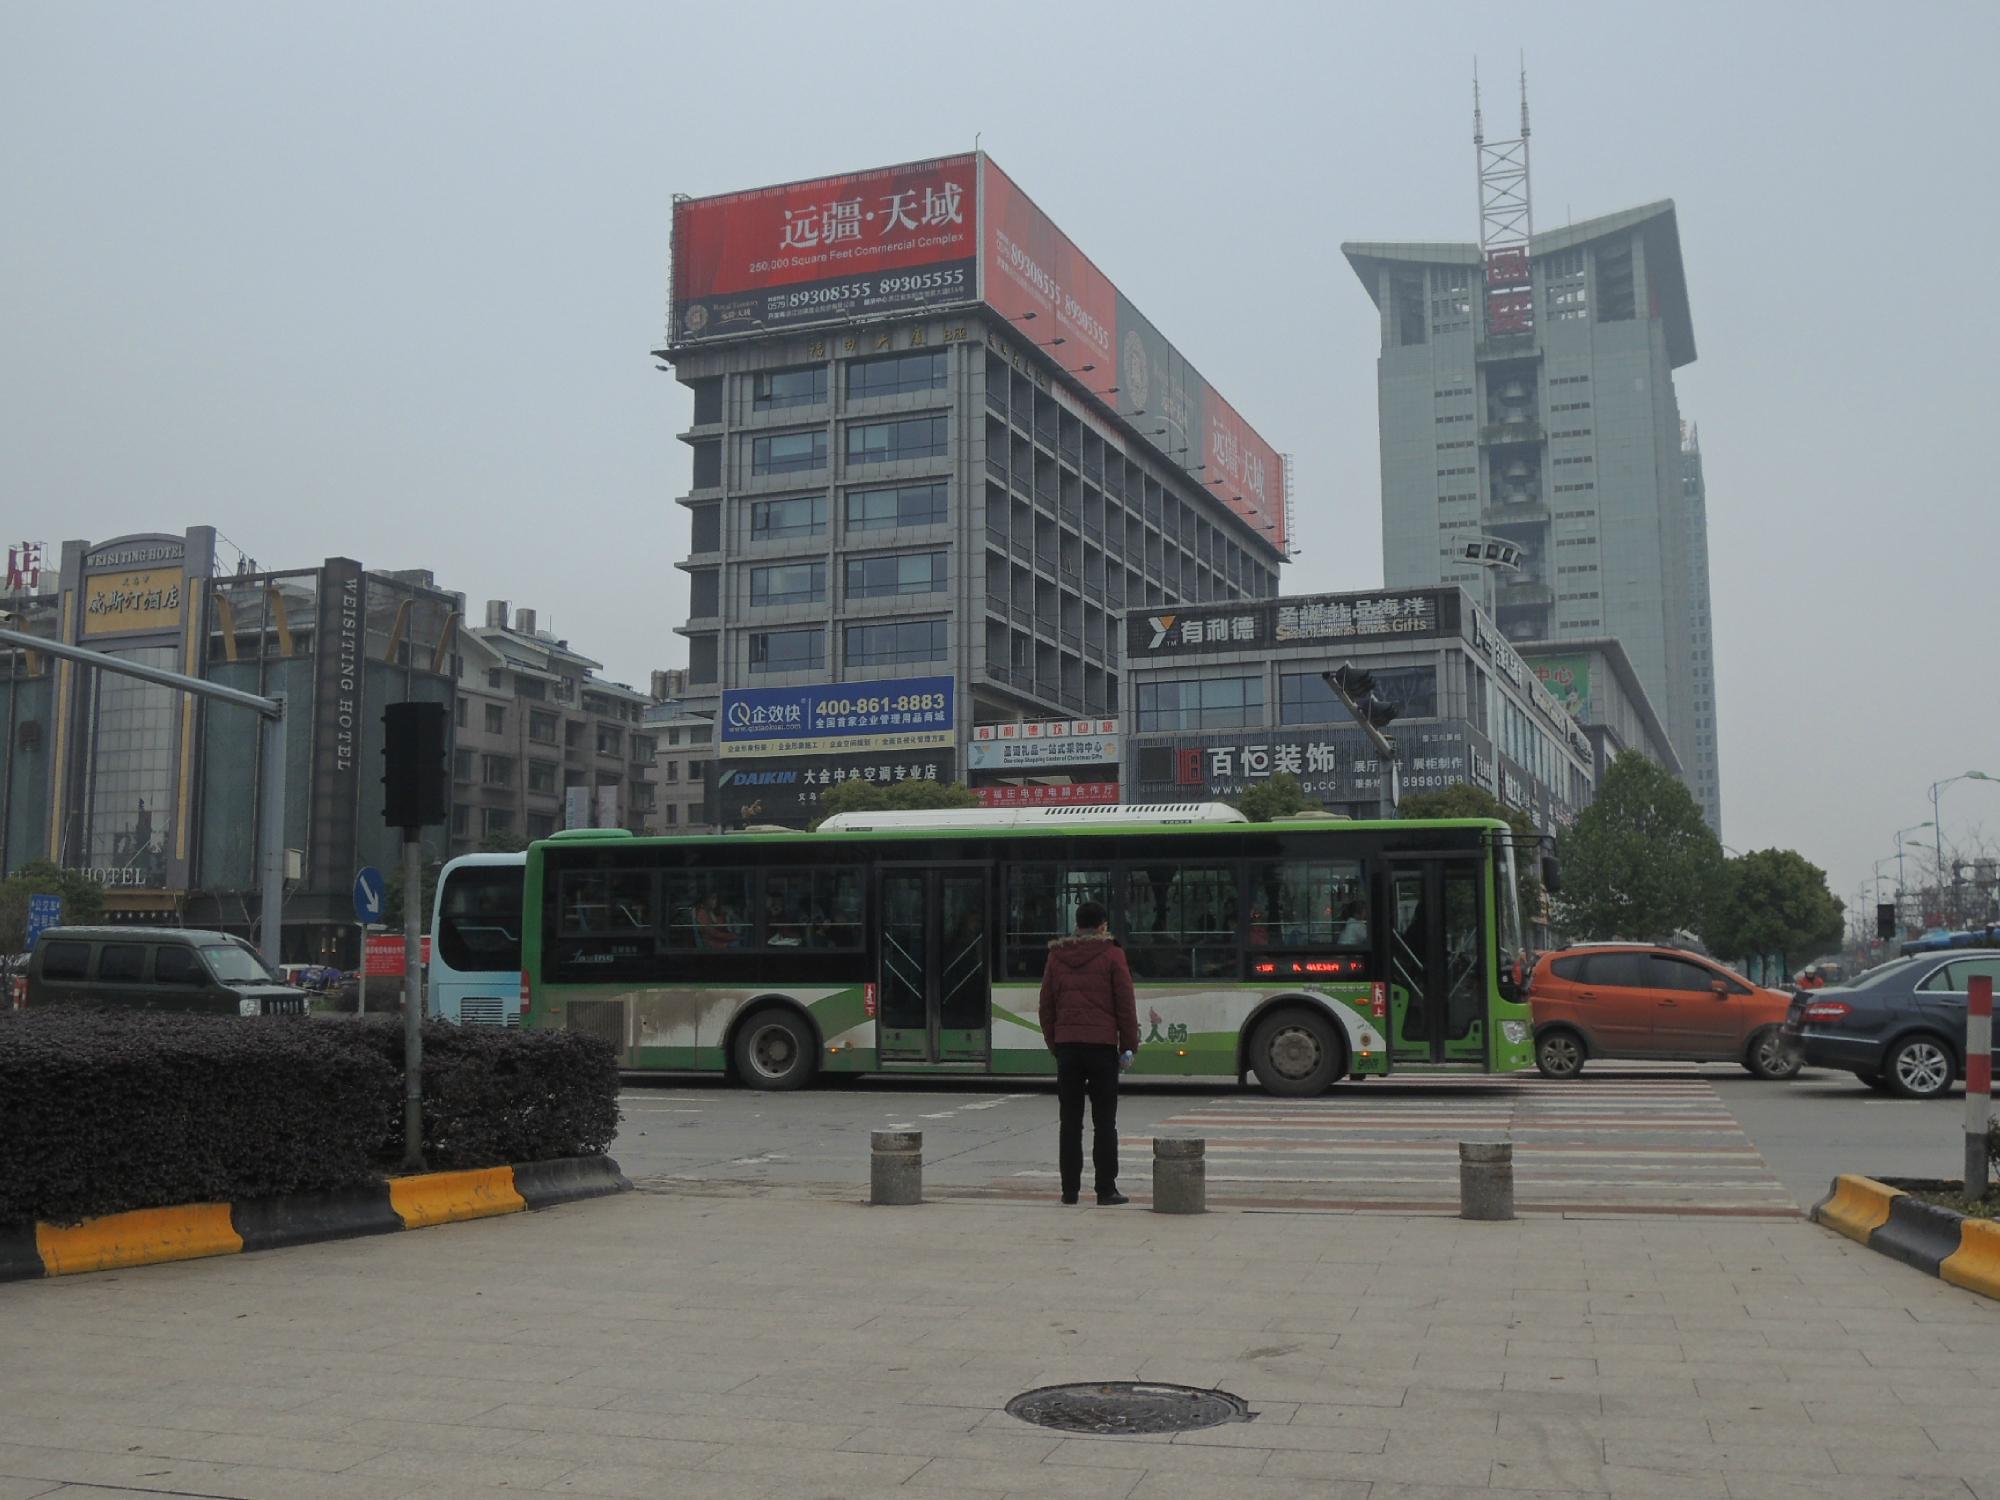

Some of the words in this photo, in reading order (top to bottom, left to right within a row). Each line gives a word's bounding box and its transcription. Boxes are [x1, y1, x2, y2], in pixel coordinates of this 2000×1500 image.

[780, 182, 964, 249] 远疆·天域
[750, 257, 789, 273] 250,000
[791, 253, 828, 267] Square
[830, 248, 853, 260] Feet
[854, 240, 915, 257] Commercial
[917, 233, 964, 248] Complex
[790, 281, 871, 309] 89308555
[879, 268, 964, 295] 89305555
[1011, 243, 1060, 305] 89308555
[1065, 294, 1109, 350] 89305555
[767, 301, 786, 311] 0579
[87, 549, 146, 567] WEISITING
[150, 543, 185, 561] HOTEL
[88, 584, 179, 616] 威斯汀酒店
[340, 577, 358, 692] WEISITING
[1181, 616, 1255, 644] 有利德
[1392, 617, 1427, 632] Gifts
[1535, 665, 1573, 684] 中心
[751, 703, 801, 724] 企效快
[816, 693, 945, 715] 400-861-8883
[815, 711, 945, 729] 全国首家企业管理用品商城
[338, 699, 353, 771] HOTEL
[1024, 756, 1045, 764] Shopping
[1207, 741, 1335, 778] 百恒装饰
[1413, 757, 1464, 771] 展柜制作
[733, 771, 798, 786] DAIKIN
[804, 763, 937, 785] 大金中央空调专业店
[1402, 774, 1464, 788] 89980188
[798, 792, 825, 802] 义乌
[81, 866, 147, 885] HOTEL
